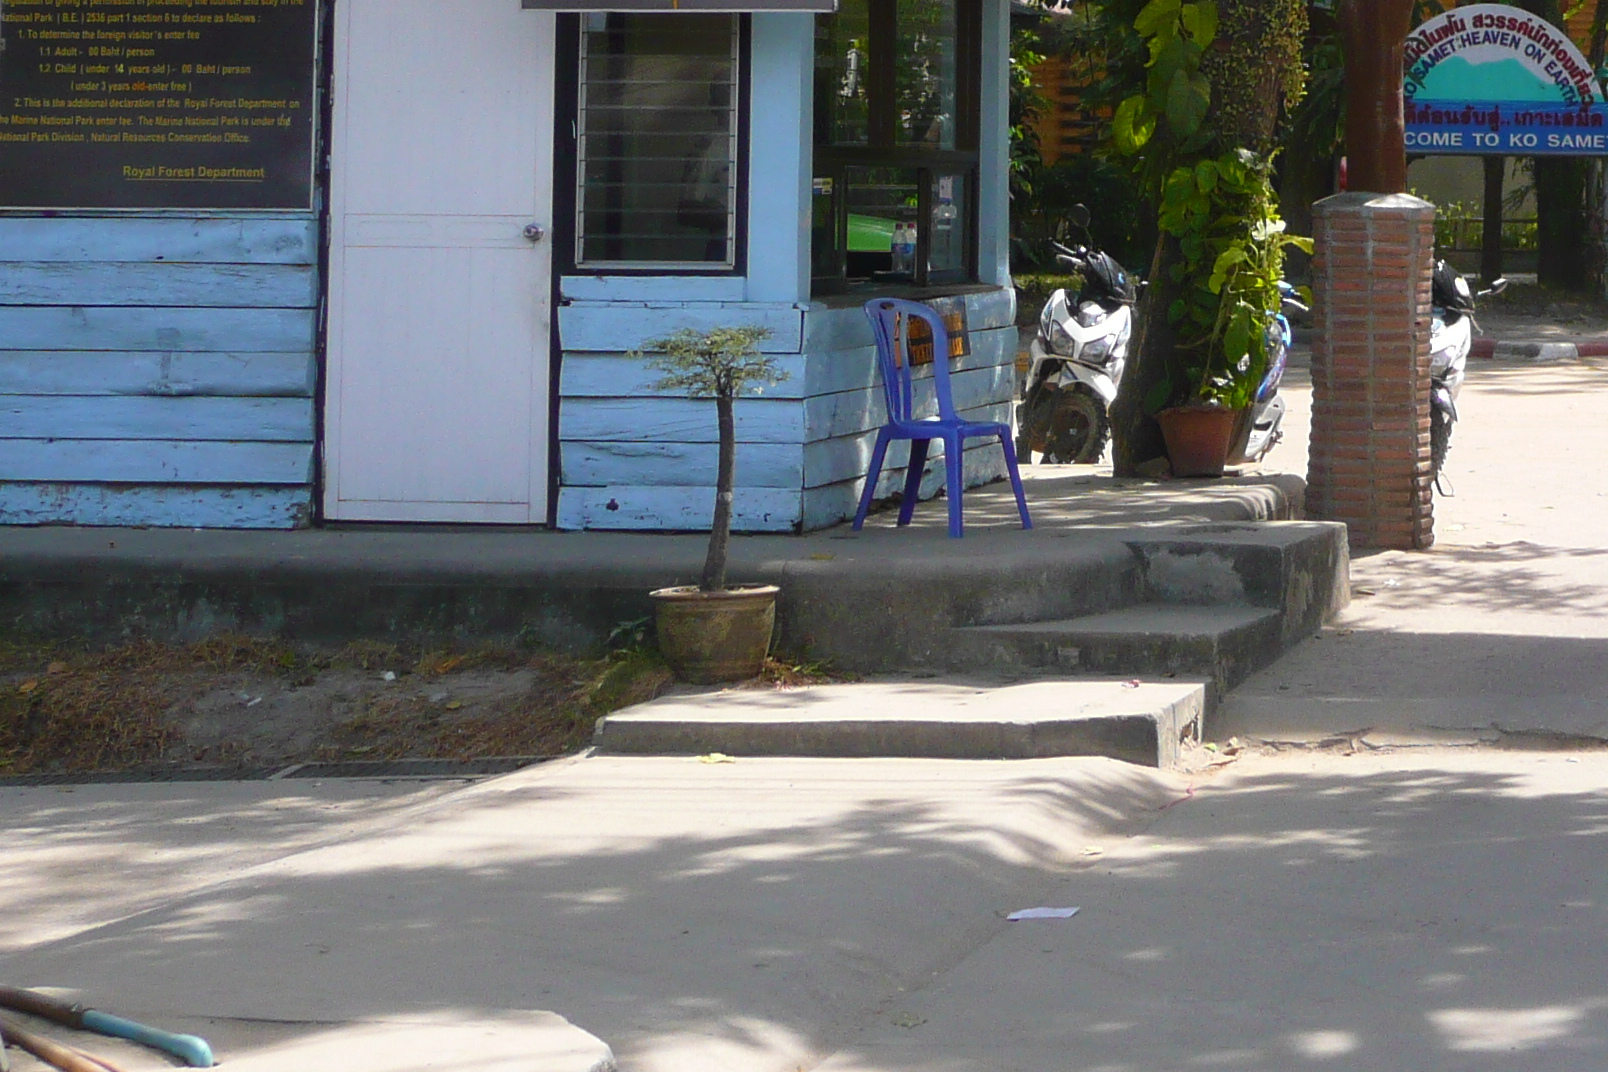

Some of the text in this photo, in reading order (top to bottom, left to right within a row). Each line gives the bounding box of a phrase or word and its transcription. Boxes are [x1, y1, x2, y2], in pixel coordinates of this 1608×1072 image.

[34, 13, 53, 23] Park
[107, 13, 124, 23] part
[132, 13, 163, 23] section
[171, 13, 180, 23] to
[181, 13, 213, 23] declare
[214, 13, 224, 23] as
[27, 29, 200, 41] To determine the foreign enter fee
[54, 47, 155, 59] Adult Baht person
[55, 64, 251, 76] Child under 14 Baht person
[1524, 44, 1547, 64] ON
[1544, 60, 1579, 106] EARTH
[75, 82, 187, 93] under years free
[24, 98, 300, 110] This is the additional declaration of the Royal Forest Department on
[11, 115, 38, 125] Marine
[40, 115, 74, 125] National
[75, 115, 94, 125] Park
[95, 115, 117, 125] enter
[138, 115, 153, 125] The
[155, 115, 183, 125] Marine
[185, 115, 219, 125] National
[220, 115, 240, 125] Park
[241, 115, 249, 125] is
[251, 115, 275, 125] under
[31, 132, 50, 142] Park
[51, 132, 84, 142] Division
[91, 132, 121, 142] Natural
[122, 132, 165, 142] Resources
[168, 132, 222, 142] Conservation
[1472, 133, 1499, 146] TO
[1509, 133, 1537, 147] KO
[123, 166, 264, 179] Royal Forest Department
